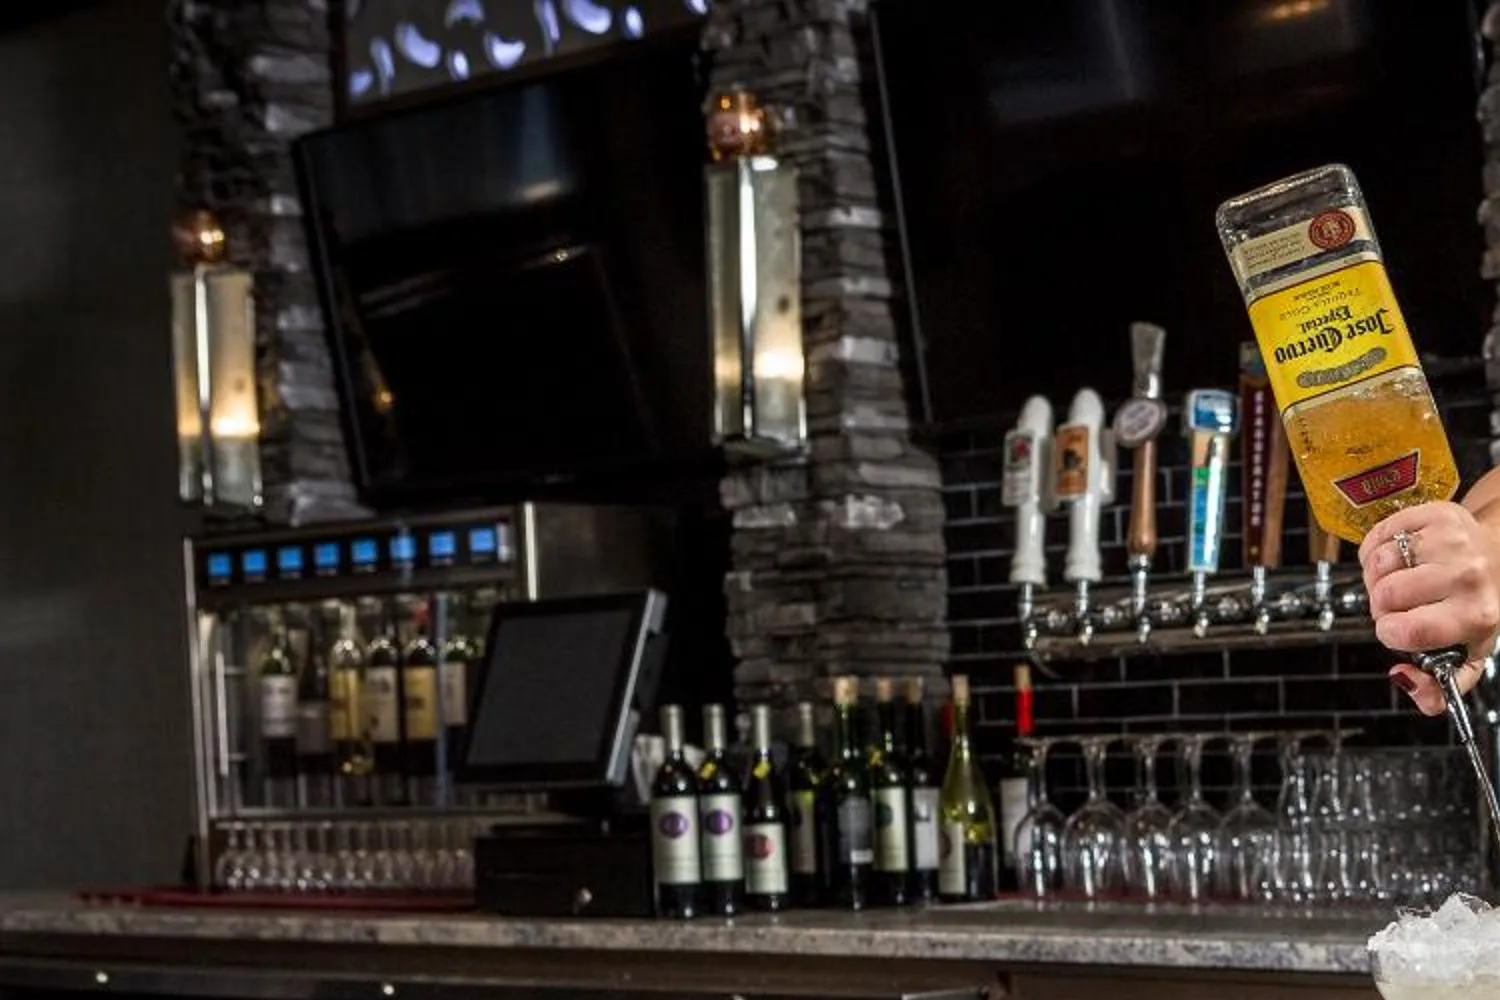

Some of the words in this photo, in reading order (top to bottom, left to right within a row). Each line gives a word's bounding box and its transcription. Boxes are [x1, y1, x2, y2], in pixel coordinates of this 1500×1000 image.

[1299, 305, 1353, 333] Especial
[1346, 308, 1395, 340] Jose
[1275, 326, 1343, 363] Cuervo
